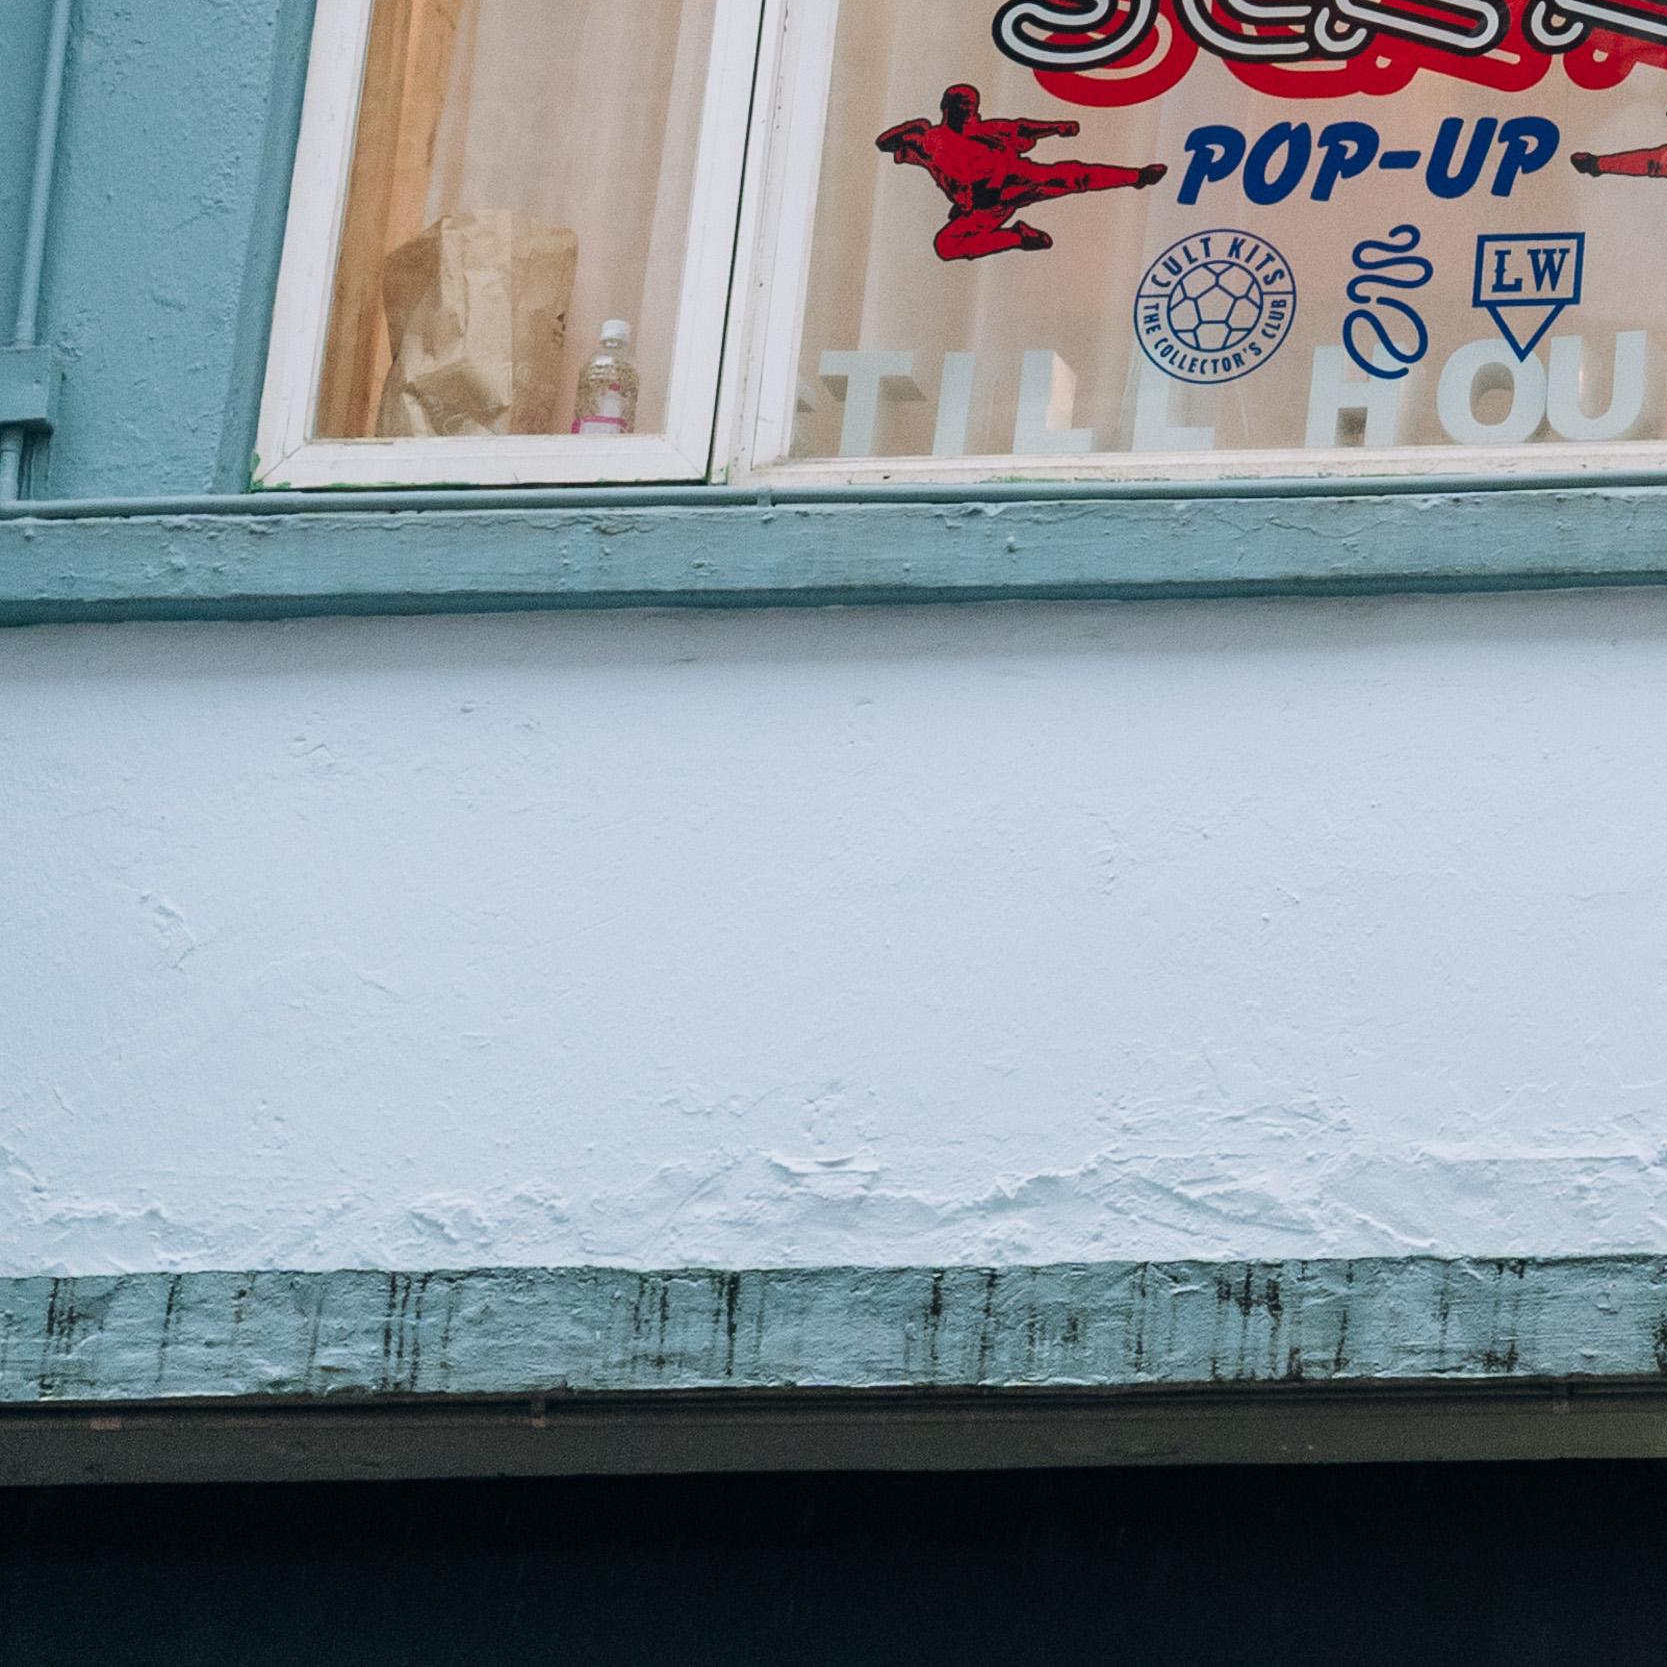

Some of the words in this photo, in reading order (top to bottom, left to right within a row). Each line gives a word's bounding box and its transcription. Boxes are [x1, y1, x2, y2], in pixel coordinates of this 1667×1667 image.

[1176, 115, 1561, 206] POP-UP
[1151, 237, 1211, 288] CULT
[1227, 237, 1285, 286] KITS
[1491, 248, 1570, 293] LW
[1143, 302, 1162, 335] THE
[1153, 337, 1263, 375] COLLECTOR'S
[1261, 298, 1287, 340] CLUB
[797, 348, 1216, 457] TILL
